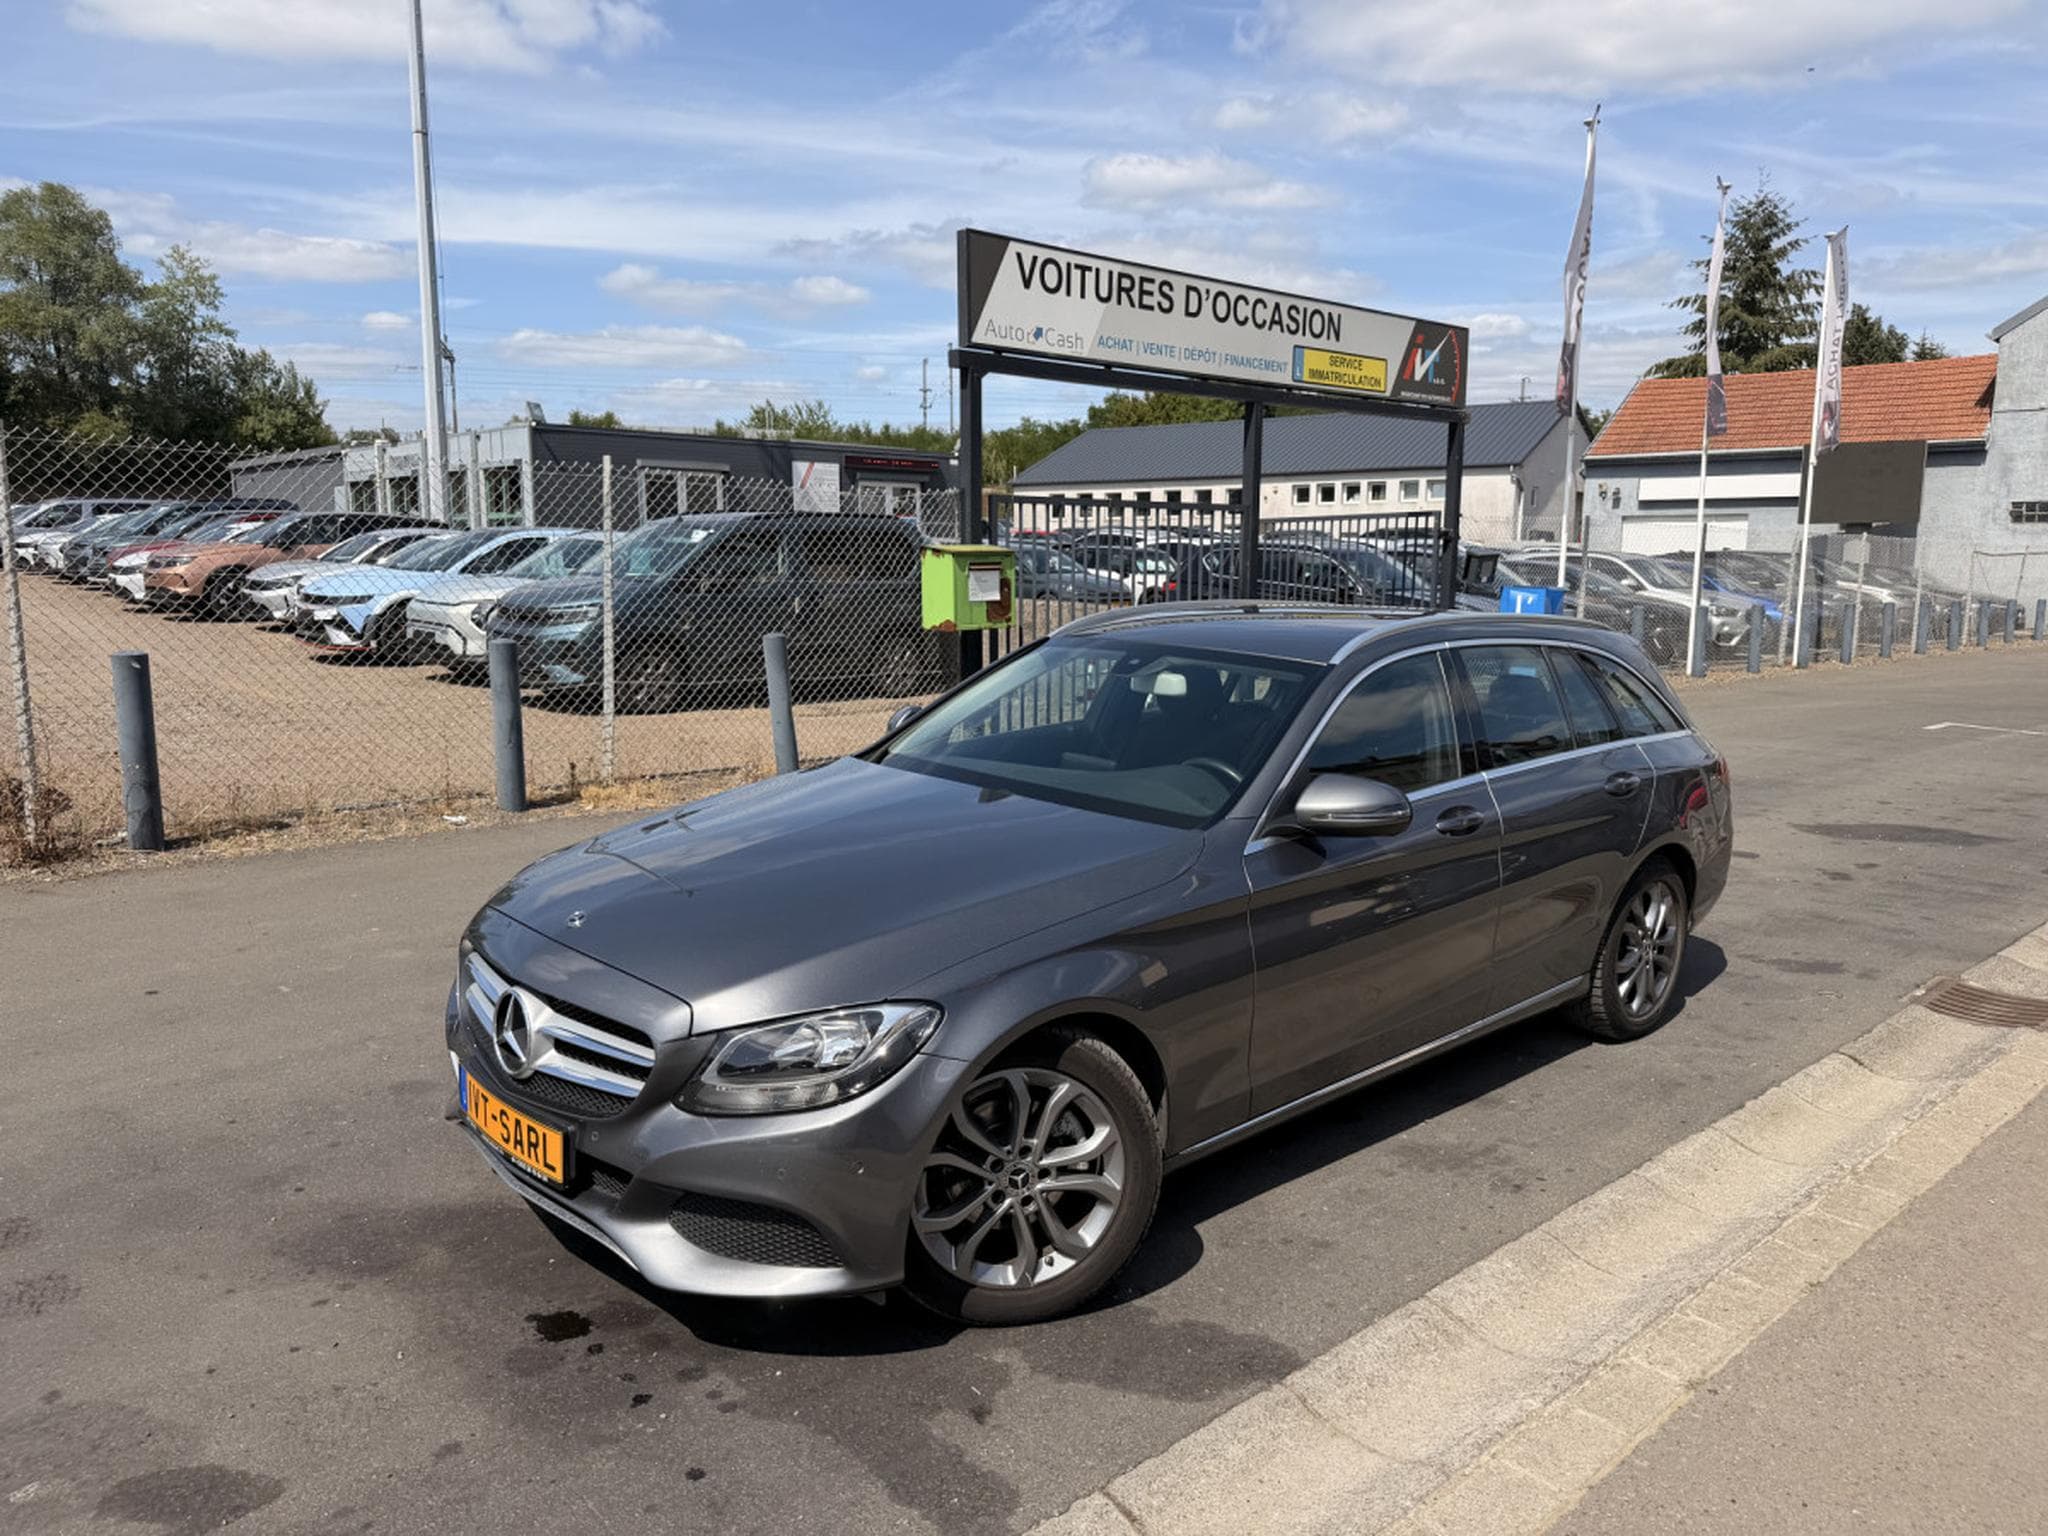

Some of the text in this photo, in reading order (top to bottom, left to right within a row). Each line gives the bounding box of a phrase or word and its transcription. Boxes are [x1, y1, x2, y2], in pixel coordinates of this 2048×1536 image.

[1016, 252, 1341, 342] VOITURES D'OCCASION
[1044, 327, 1084, 349] Cash
[1097, 336, 1134, 351] ACHAT
[1142, 342, 1176, 358] VENTE
[1224, 353, 1288, 374] FINANCEMENT
[1328, 355, 1364, 371] SERVICE
[1825, 327, 1843, 390] ACHAT
[1308, 368, 1382, 388] IMMATRICULATION
[468, 1080, 557, 1173] IVT-SARL
